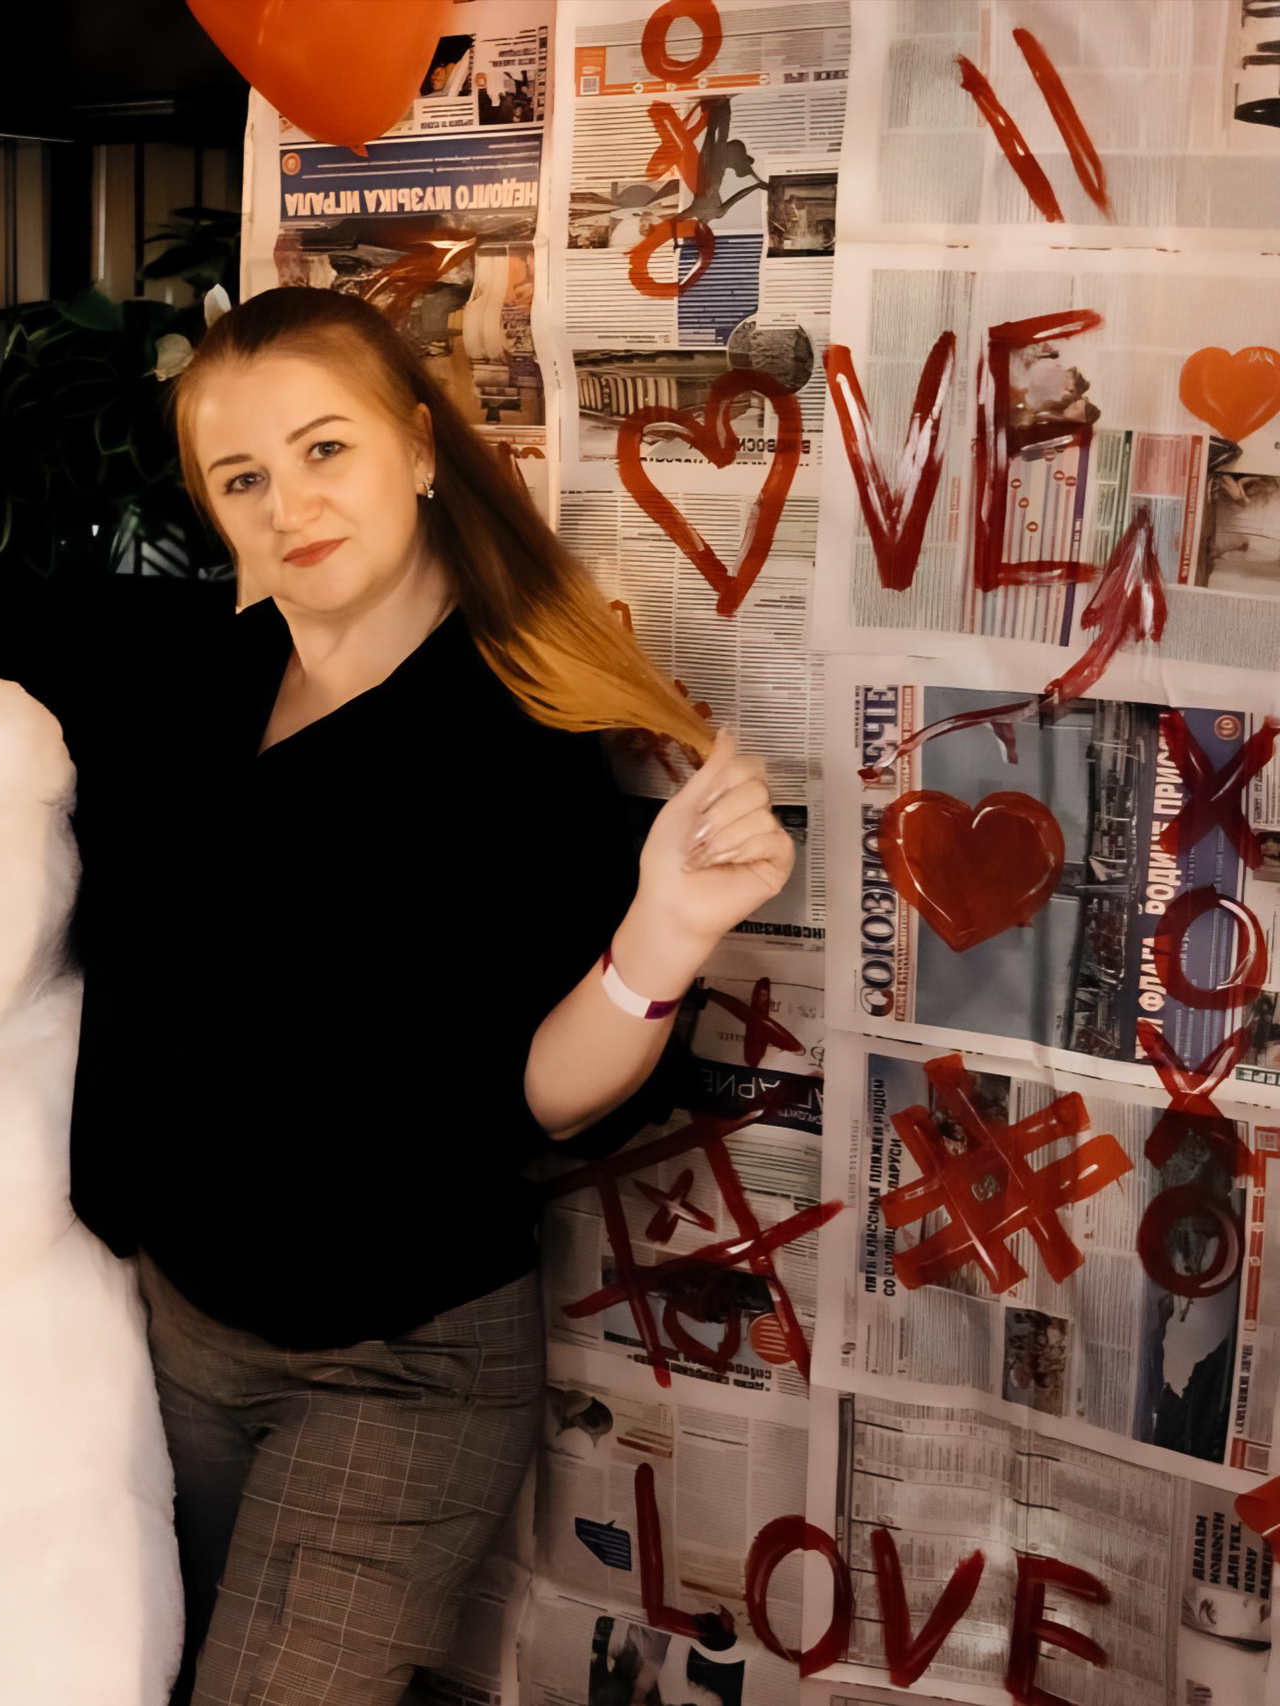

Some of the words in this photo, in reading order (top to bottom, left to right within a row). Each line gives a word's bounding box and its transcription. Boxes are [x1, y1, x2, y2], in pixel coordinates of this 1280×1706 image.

[284, 190, 360, 216] ИГРАЛА
[363, 185, 451, 213] МУЗЫКА
[455, 178, 538, 210] НЕДОЛГО
[865, 1261, 877, 1293] ПЯТЬ
[883, 1279, 895, 1297] СО
[1192, 1515, 1208, 1580] ДЕЛАЕМ
[1210, 1511, 1224, 1584] НОВОСТИ
[634, 1462, 1110, 1704] LOVE
[1227, 1555, 1240, 1589] ДЛЯ
[1244, 1547, 1257, 1593] КОМУ
